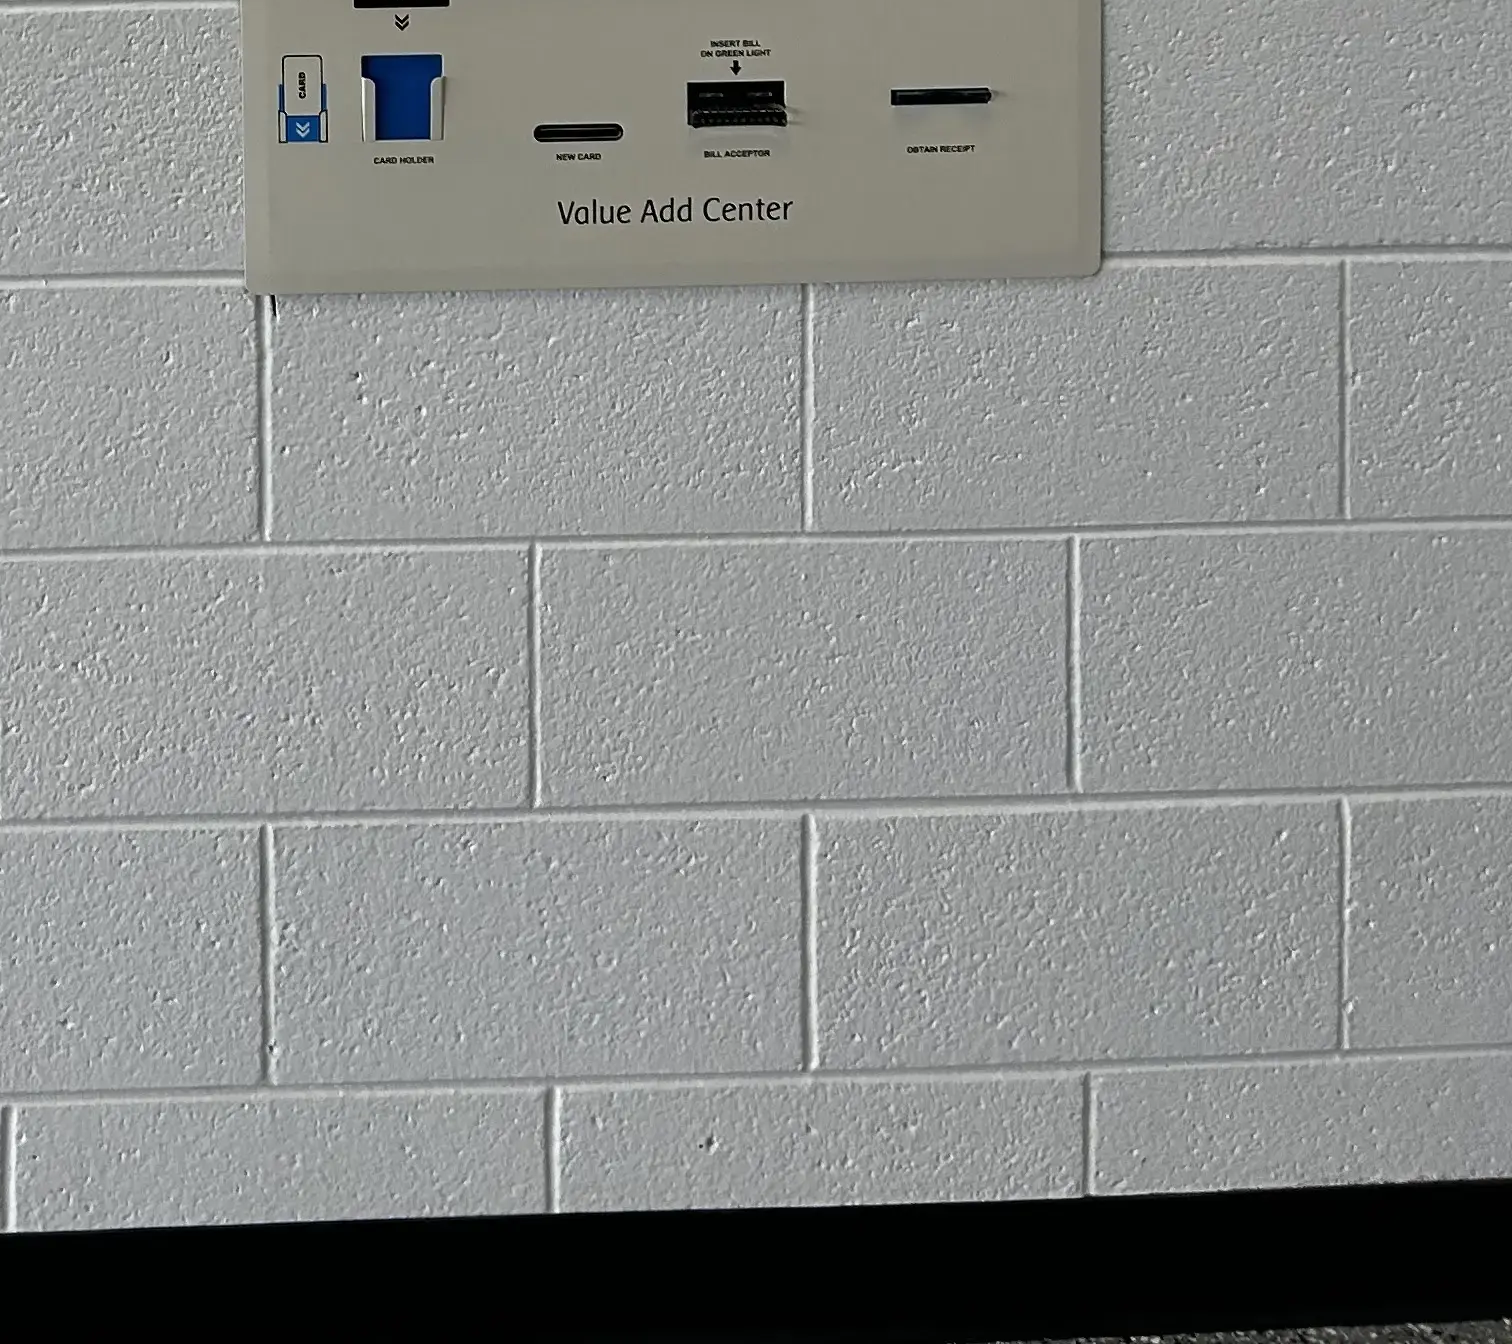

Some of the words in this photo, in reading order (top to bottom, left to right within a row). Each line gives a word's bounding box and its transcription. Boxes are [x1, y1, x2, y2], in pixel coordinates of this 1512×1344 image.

[710, 40, 740, 48] INSERT
[742, 39, 761, 47] BILL
[700, 50, 714, 58] ON
[715, 49, 744, 57] GREEN
[746, 49, 771, 57] LIGHT
[298, 72, 306, 99] CARD
[704, 150, 722, 158] BILL
[724, 149, 770, 158] ACCEPTOR
[906, 145, 938, 154] OBTAIN
[939, 144, 975, 153] RECEIPT
[373, 156, 397, 164] CARD
[399, 156, 434, 164] HOLDER
[556, 153, 576, 161] NEW
[578, 153, 601, 161] CARD
[557, 199, 632, 225] Value
[640, 197, 692, 224] Add
[703, 197, 794, 222] Center
